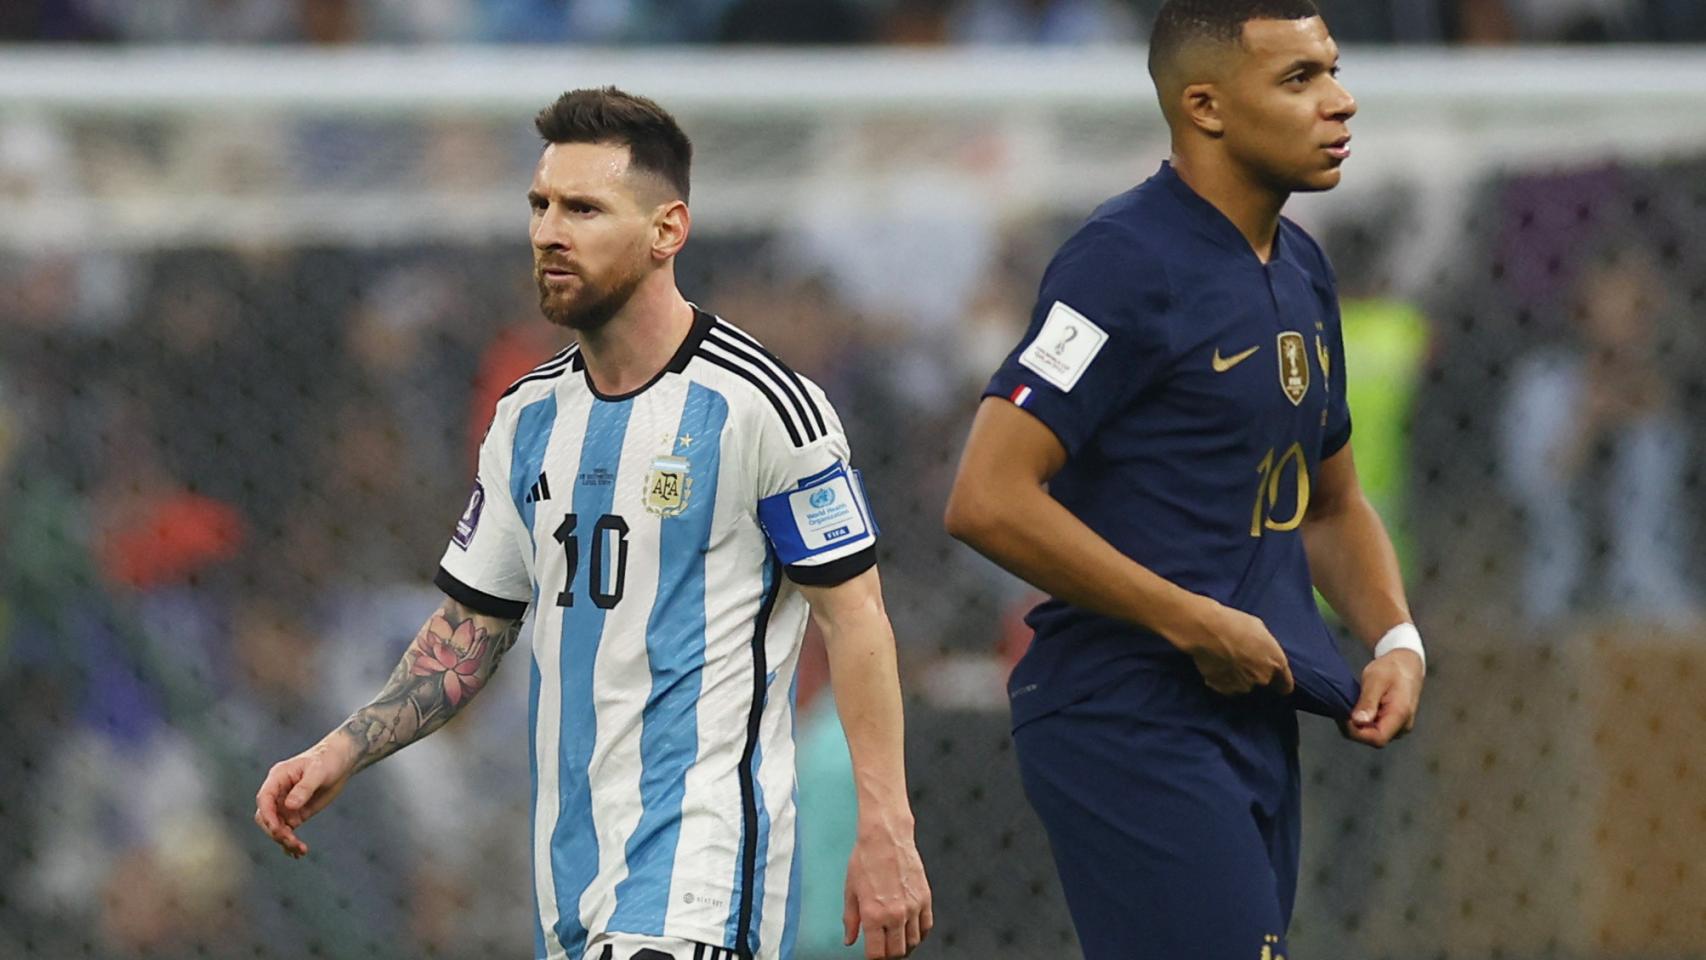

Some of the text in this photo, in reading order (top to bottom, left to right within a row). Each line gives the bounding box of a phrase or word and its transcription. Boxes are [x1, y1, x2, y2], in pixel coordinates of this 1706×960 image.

[652, 471, 679, 501] AFA
[1250, 442, 1309, 537] 10
[806, 509, 826, 520] World
[826, 528, 847, 540] FIFA
[552, 513, 630, 610] 10
